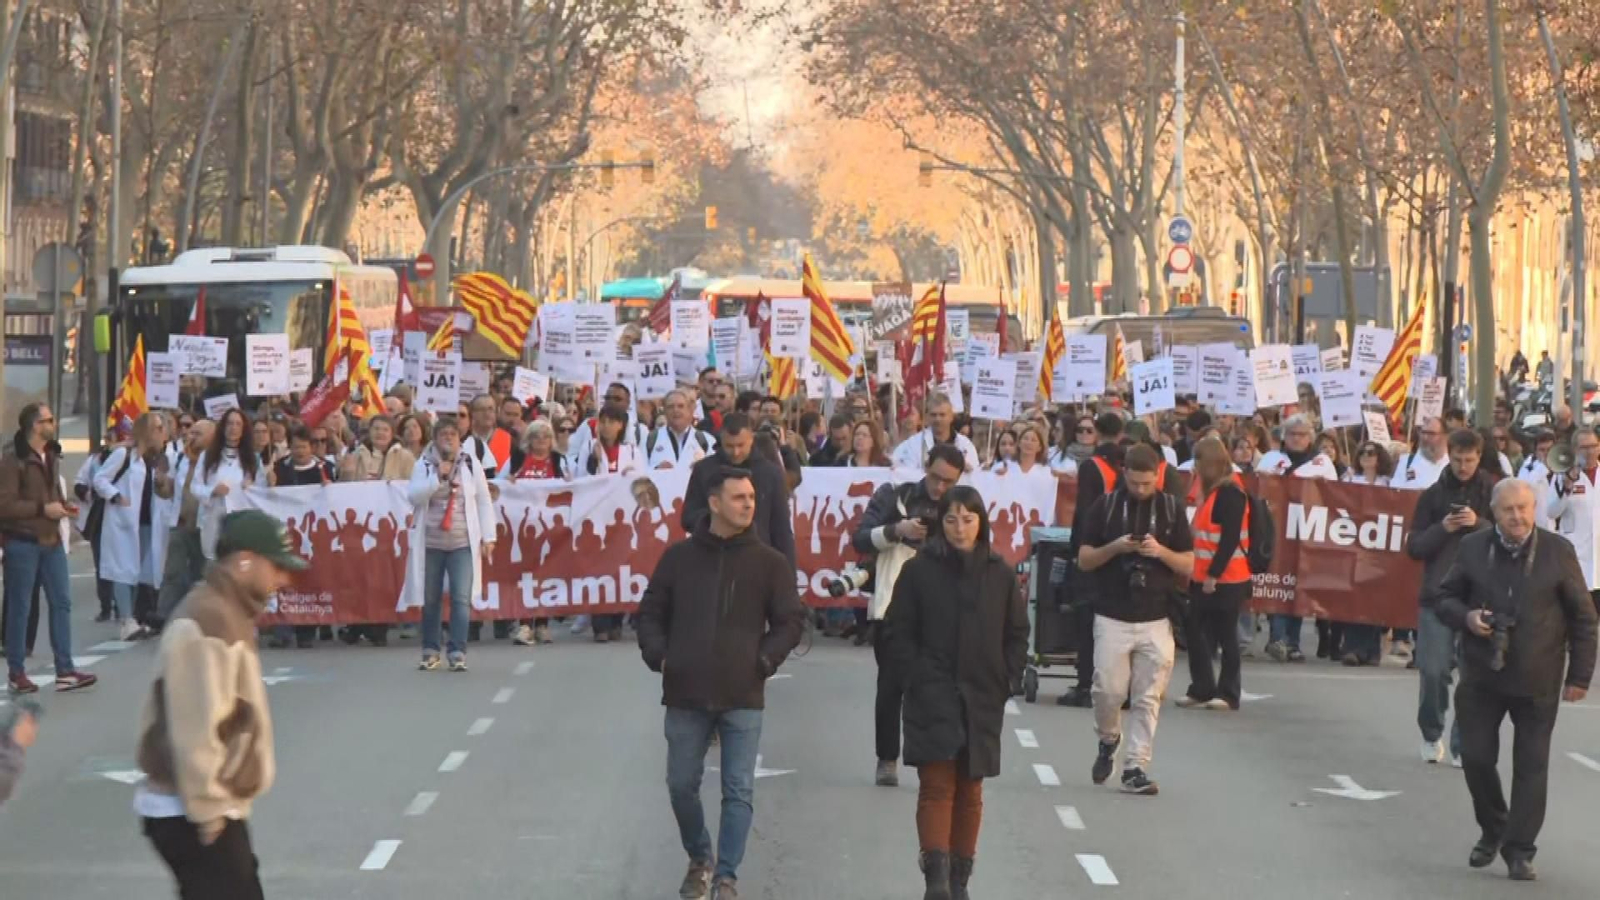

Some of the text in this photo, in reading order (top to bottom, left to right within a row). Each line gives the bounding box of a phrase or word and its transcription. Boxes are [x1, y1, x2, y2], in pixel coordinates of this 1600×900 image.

[641, 362, 668, 378] JA!
[423, 373, 455, 389] JA!
[1140, 376, 1168, 394] JA!
[1285, 502, 1409, 553] Mèdi
[517, 564, 649, 608] tamb
[1252, 586, 1295, 602] talunya
